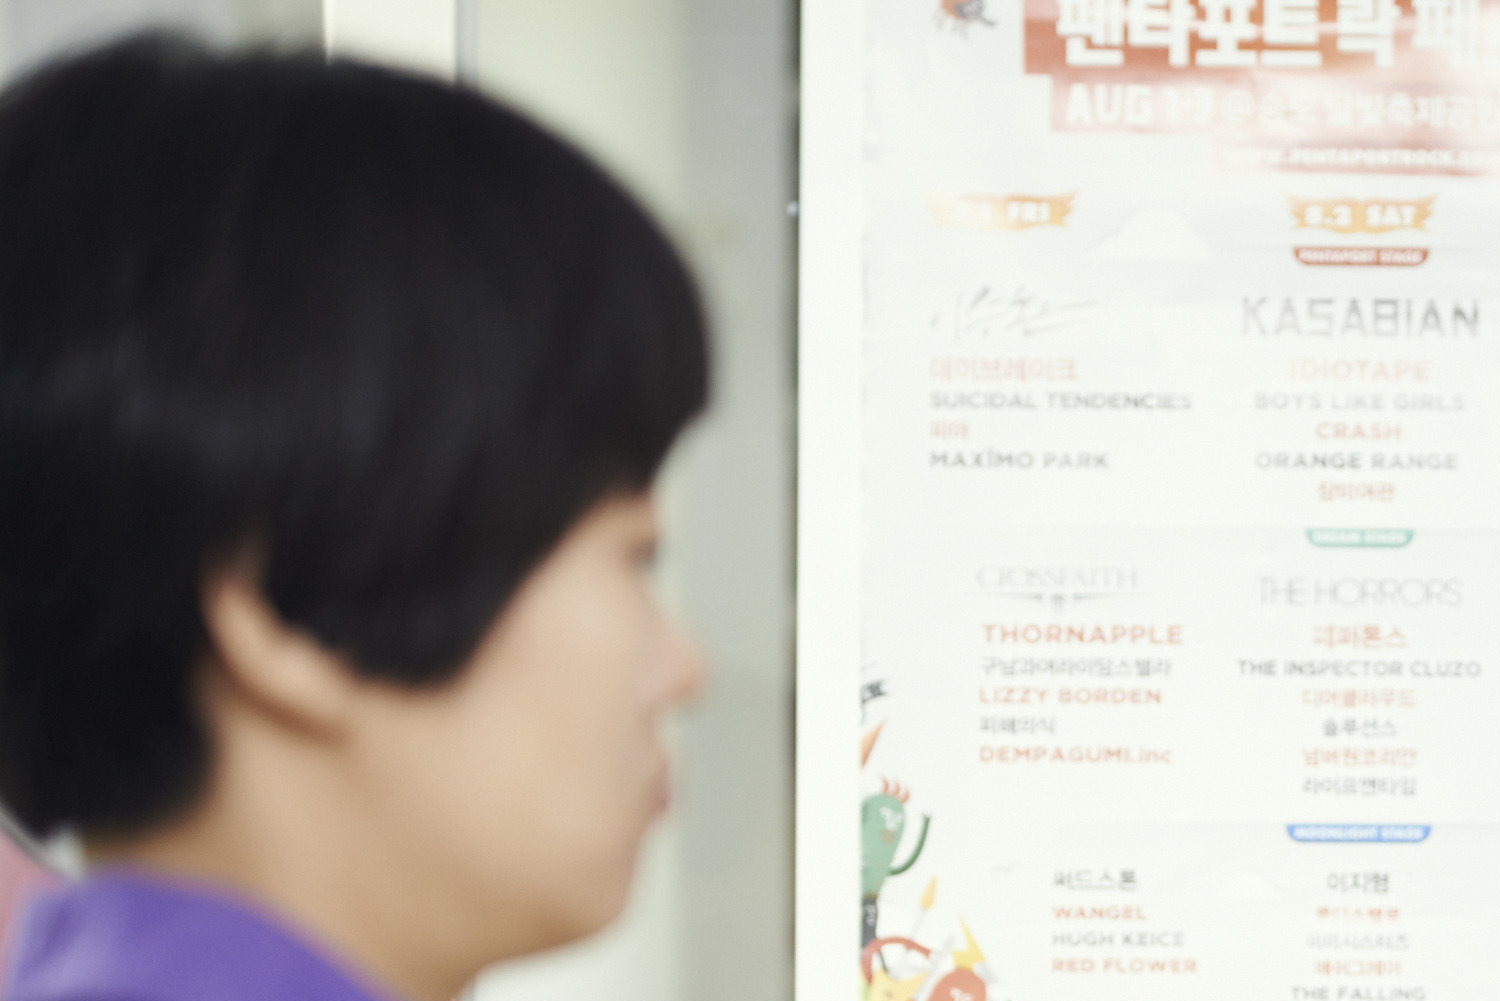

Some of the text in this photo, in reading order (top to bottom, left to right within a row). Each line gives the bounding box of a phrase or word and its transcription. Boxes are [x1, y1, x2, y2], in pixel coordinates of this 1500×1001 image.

[1066, 83, 1153, 124] AUG
[1366, 204, 1416, 226] SAT
[1241, 297, 1480, 338] KASABIAN
[1289, 358, 1432, 382] IDIOTAPE
[930, 390, 1193, 411] SUICIDAL TENDENCIES
[1253, 392, 1466, 411] BOYS LIKE GIRLS
[1314, 421, 1403, 440] CRASH
[1043, 450, 1111, 470] PARK
[1254, 452, 1458, 471] ORANGE RANGE
[1257, 575, 1464, 607] THE HORRORS
[980, 623, 1184, 646] THORNAPPLE
[1237, 659, 1482, 678] THE INSPECTOR CLUZO
[978, 687, 1163, 705] LIZZY BORDEN
[978, 745, 1173, 764] DEMPAGUMI.inc
[1052, 905, 1148, 921] WANGEL
[1052, 931, 1187, 948] HUGH KEICE
[1052, 958, 1198, 974] RED FLOWER
[1291, 985, 1427, 1001] THE FALLING
